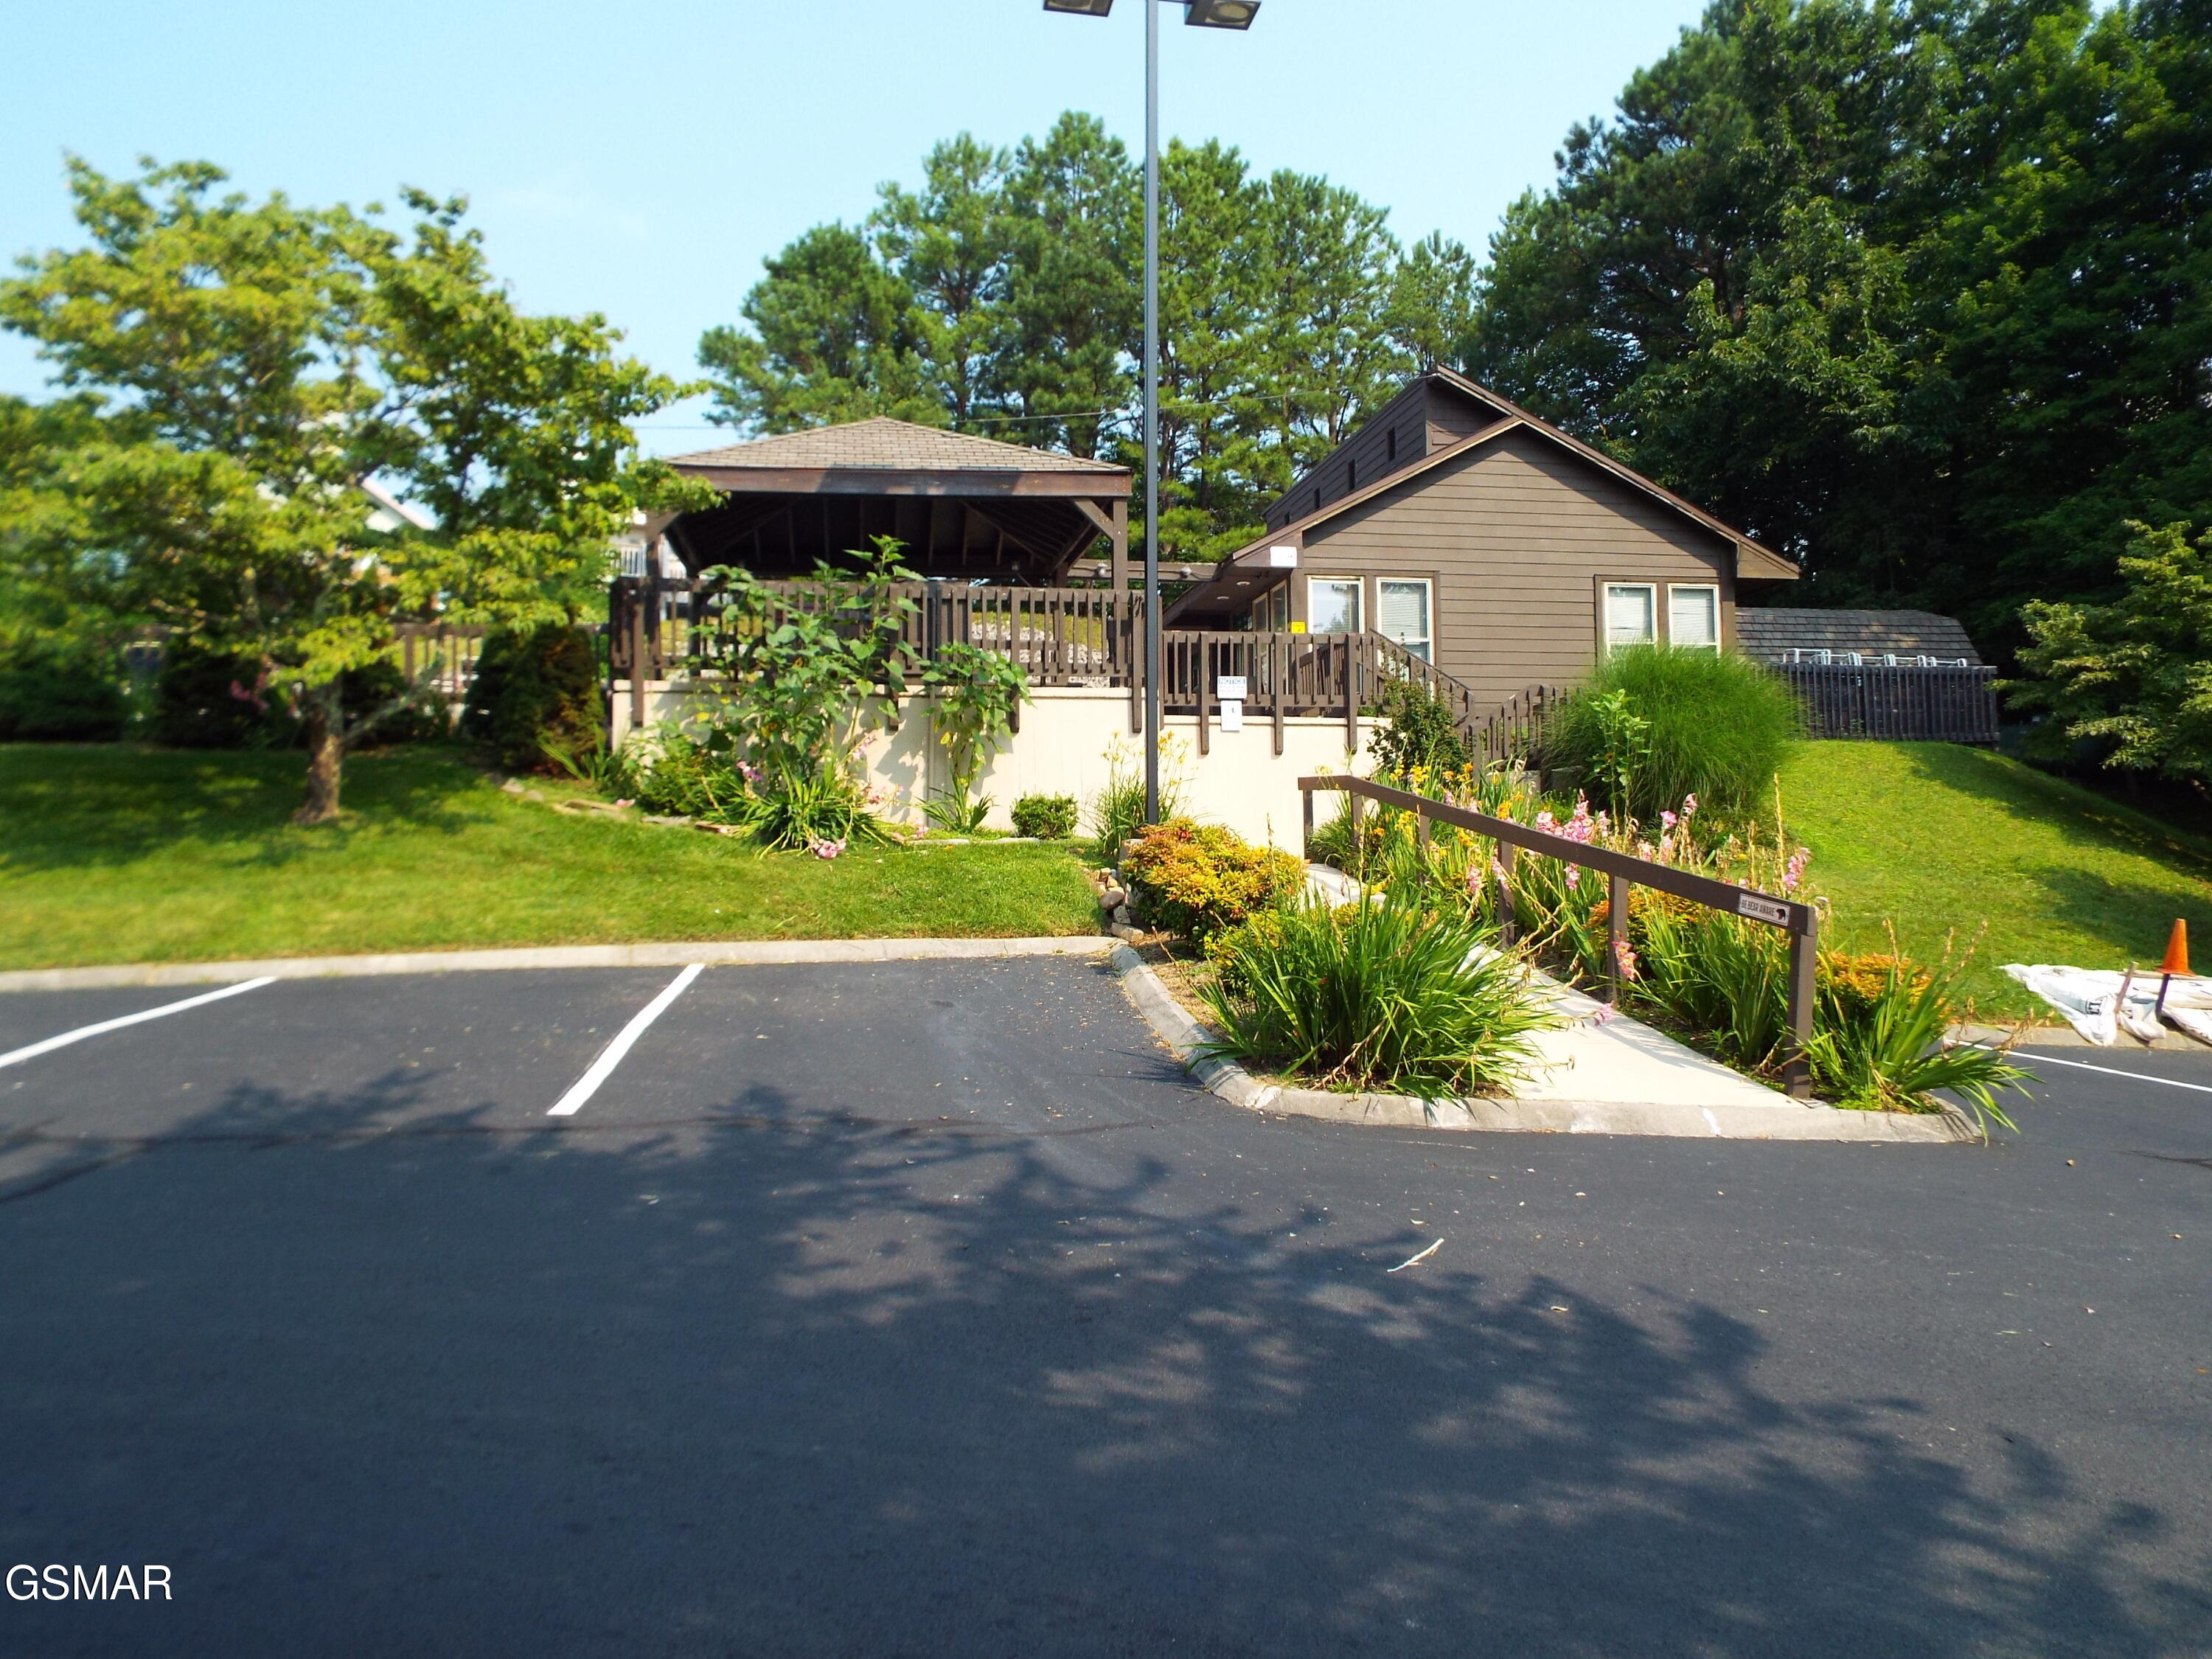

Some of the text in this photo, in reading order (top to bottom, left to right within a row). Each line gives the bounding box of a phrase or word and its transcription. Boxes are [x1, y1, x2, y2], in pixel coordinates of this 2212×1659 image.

[1741, 900, 1775, 917] BE BEAR AWARE
